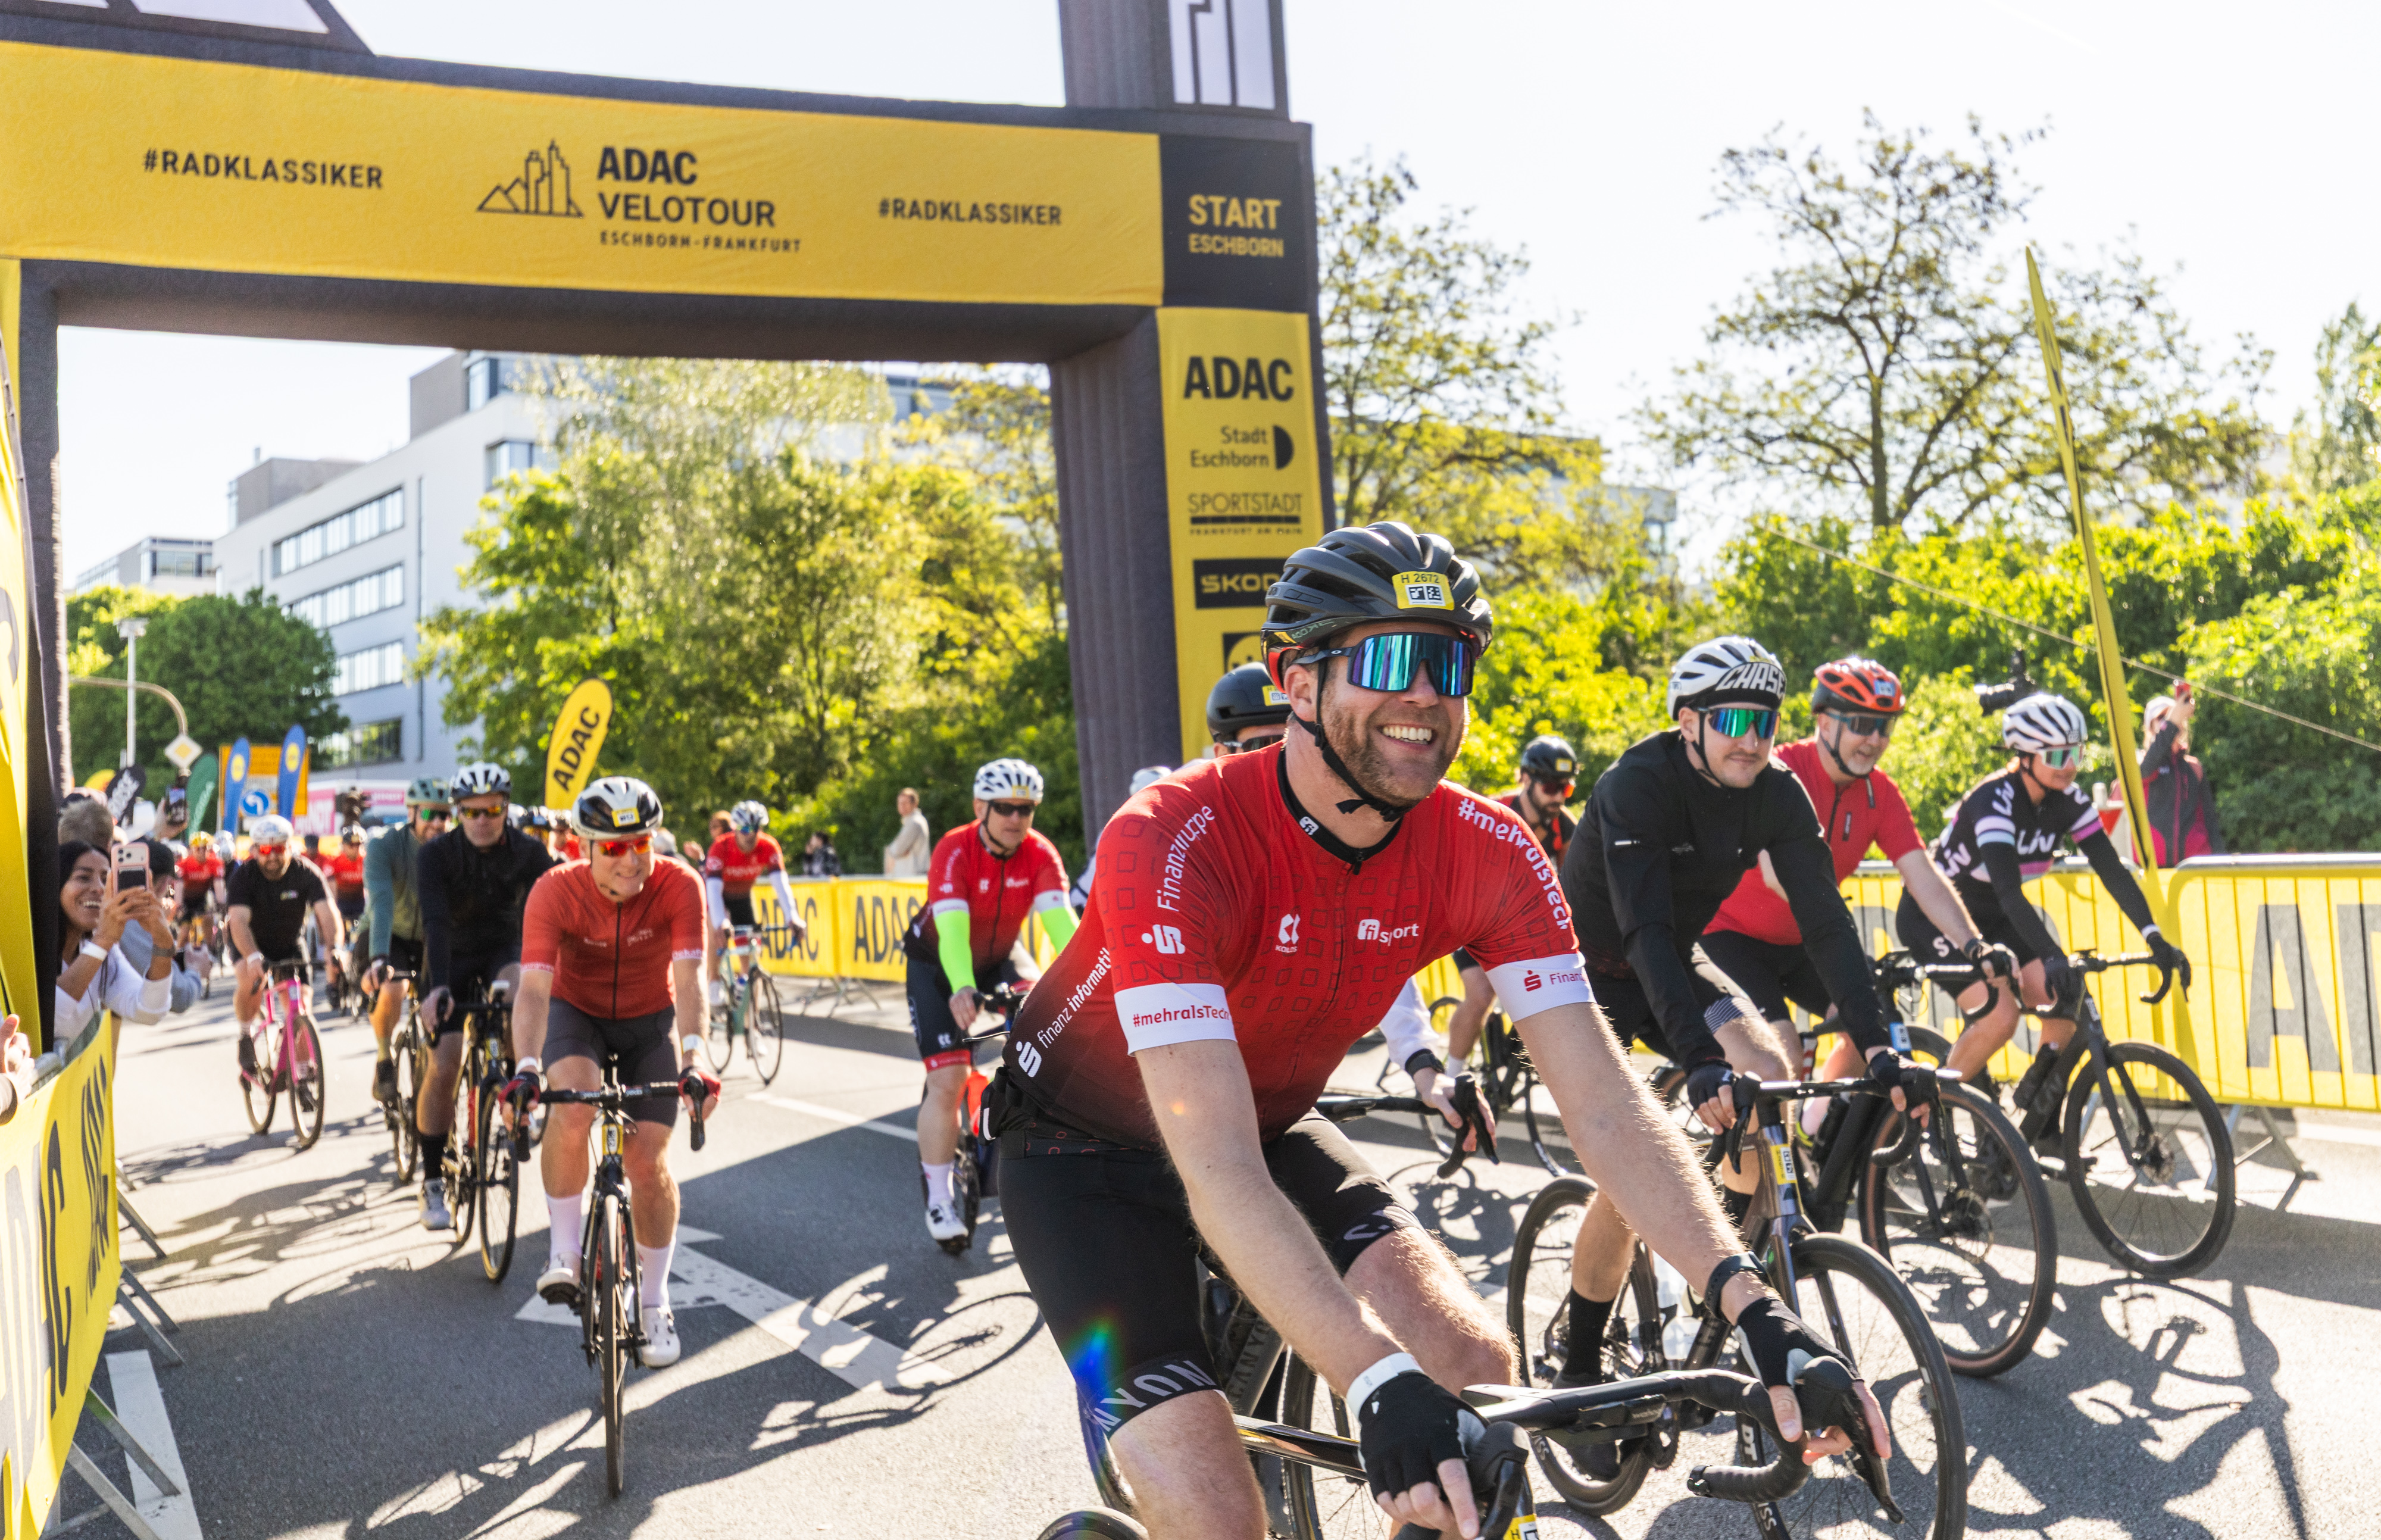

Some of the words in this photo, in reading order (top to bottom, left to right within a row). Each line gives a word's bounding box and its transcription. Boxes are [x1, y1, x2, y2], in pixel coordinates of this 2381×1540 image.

[143, 148, 384, 189] #RADKLASSIKER
[597, 146, 698, 186] ADAC
[598, 192, 776, 227] VELOTOUR
[879, 197, 1062, 226] #RADKLASSIKER
[1189, 194, 1281, 230] START
[1189, 233, 1283, 257] ESCHBORN
[1183, 356, 1294, 401] ADAC
[1221, 426, 1268, 444] Stadt
[1190, 448, 1268, 468] Eschborn
[1188, 492, 1302, 514] SPORTSTADT
[1401, 574, 1410, 583] H
[1414, 573, 1439, 583] 2672
[553, 706, 600, 792] ADAC
[1992, 780, 2014, 816] Liv
[2017, 829, 2056, 855] Liv
[1037, 1007, 1073, 1048] finanz
